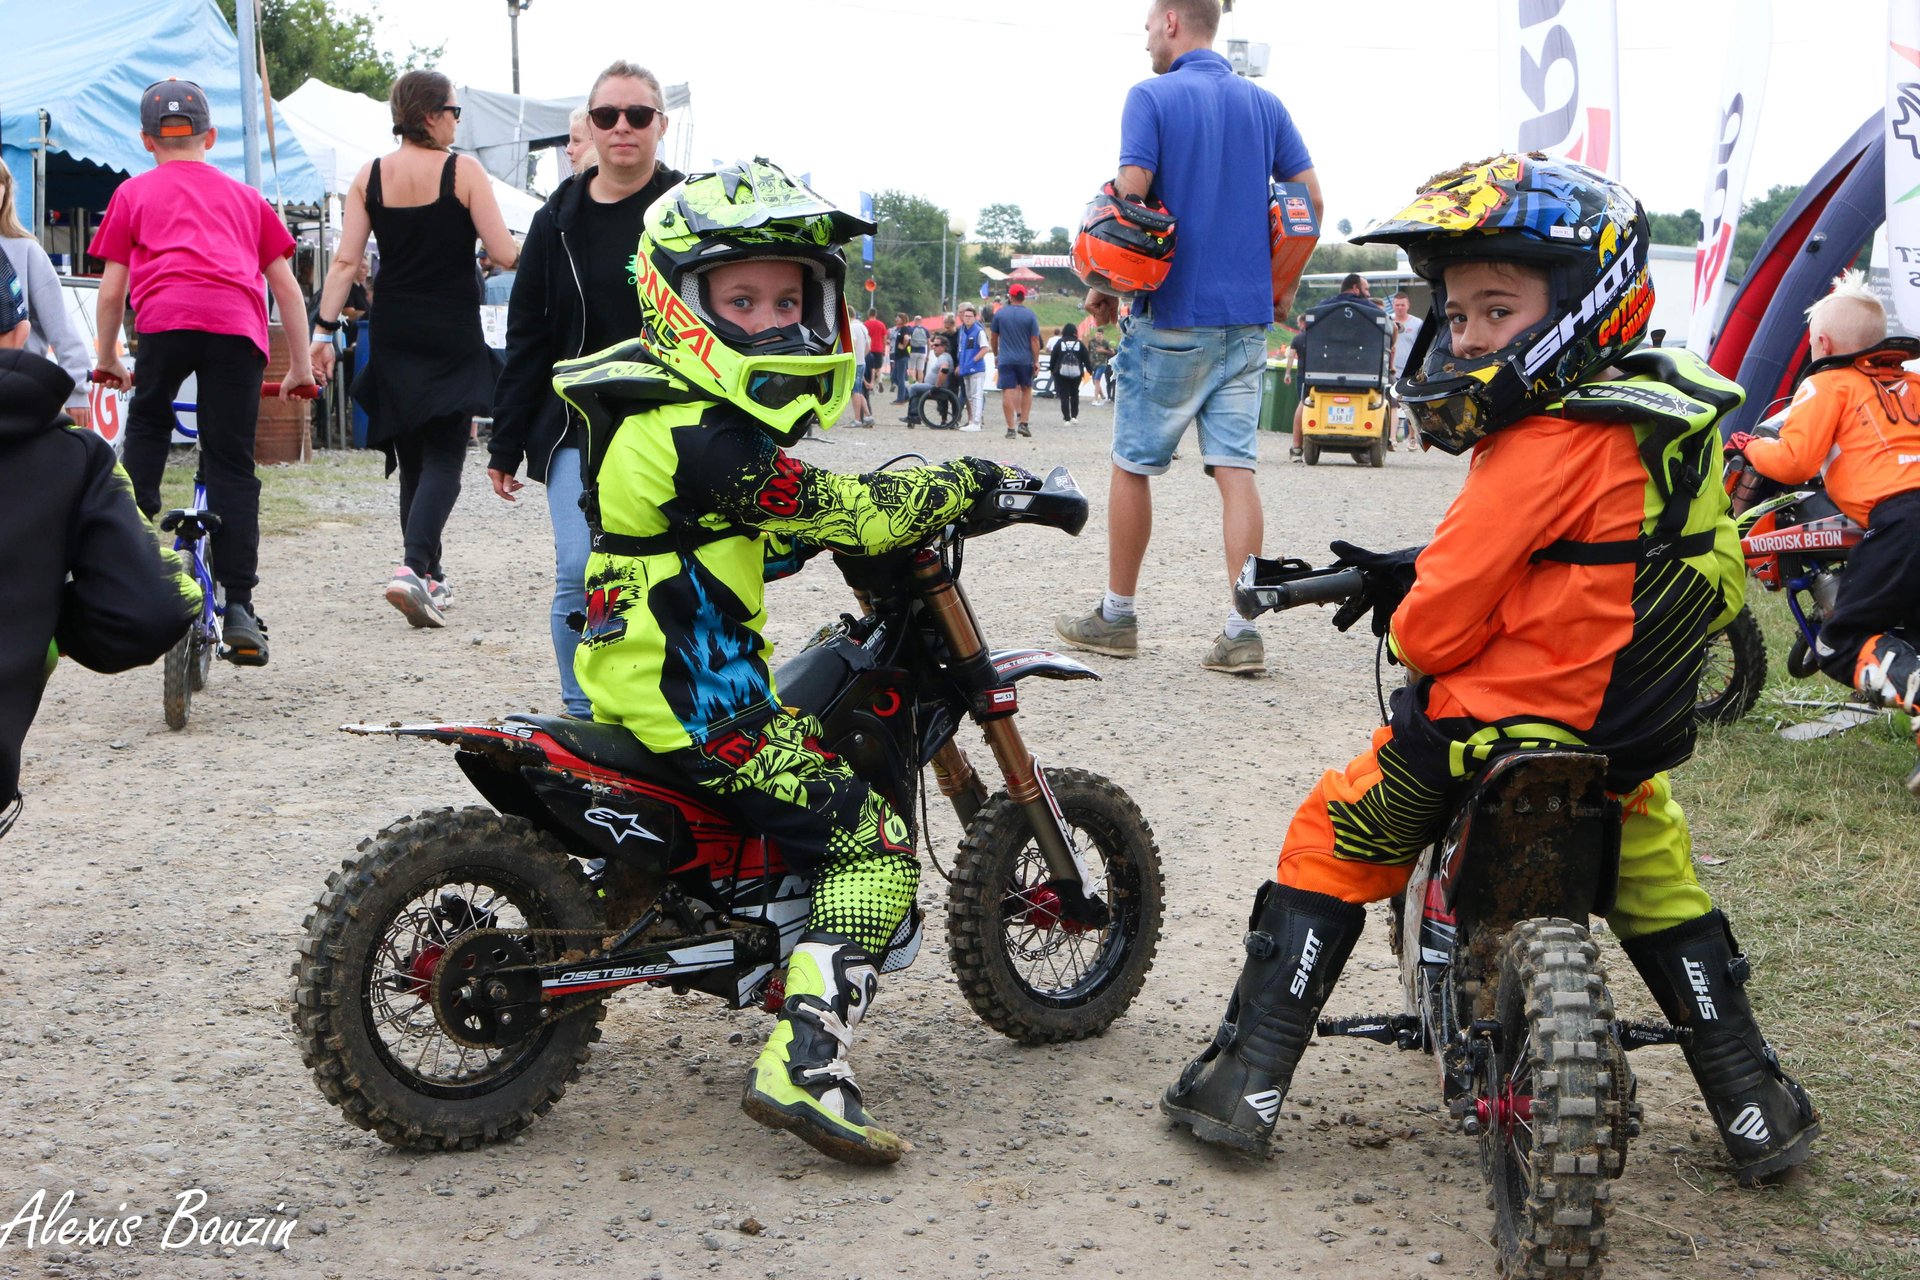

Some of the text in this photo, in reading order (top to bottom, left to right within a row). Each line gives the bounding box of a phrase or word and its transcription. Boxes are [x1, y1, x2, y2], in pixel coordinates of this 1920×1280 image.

[1344, 306, 1353, 318] 5
[1524, 235, 1638, 377] SHOT
[1750, 530, 1842, 553] NORDISK BETON
[559, 963, 670, 983] OSETBIKES
[1289, 927, 1321, 1000] SHOT
[1681, 956, 1719, 1020] SHOT
